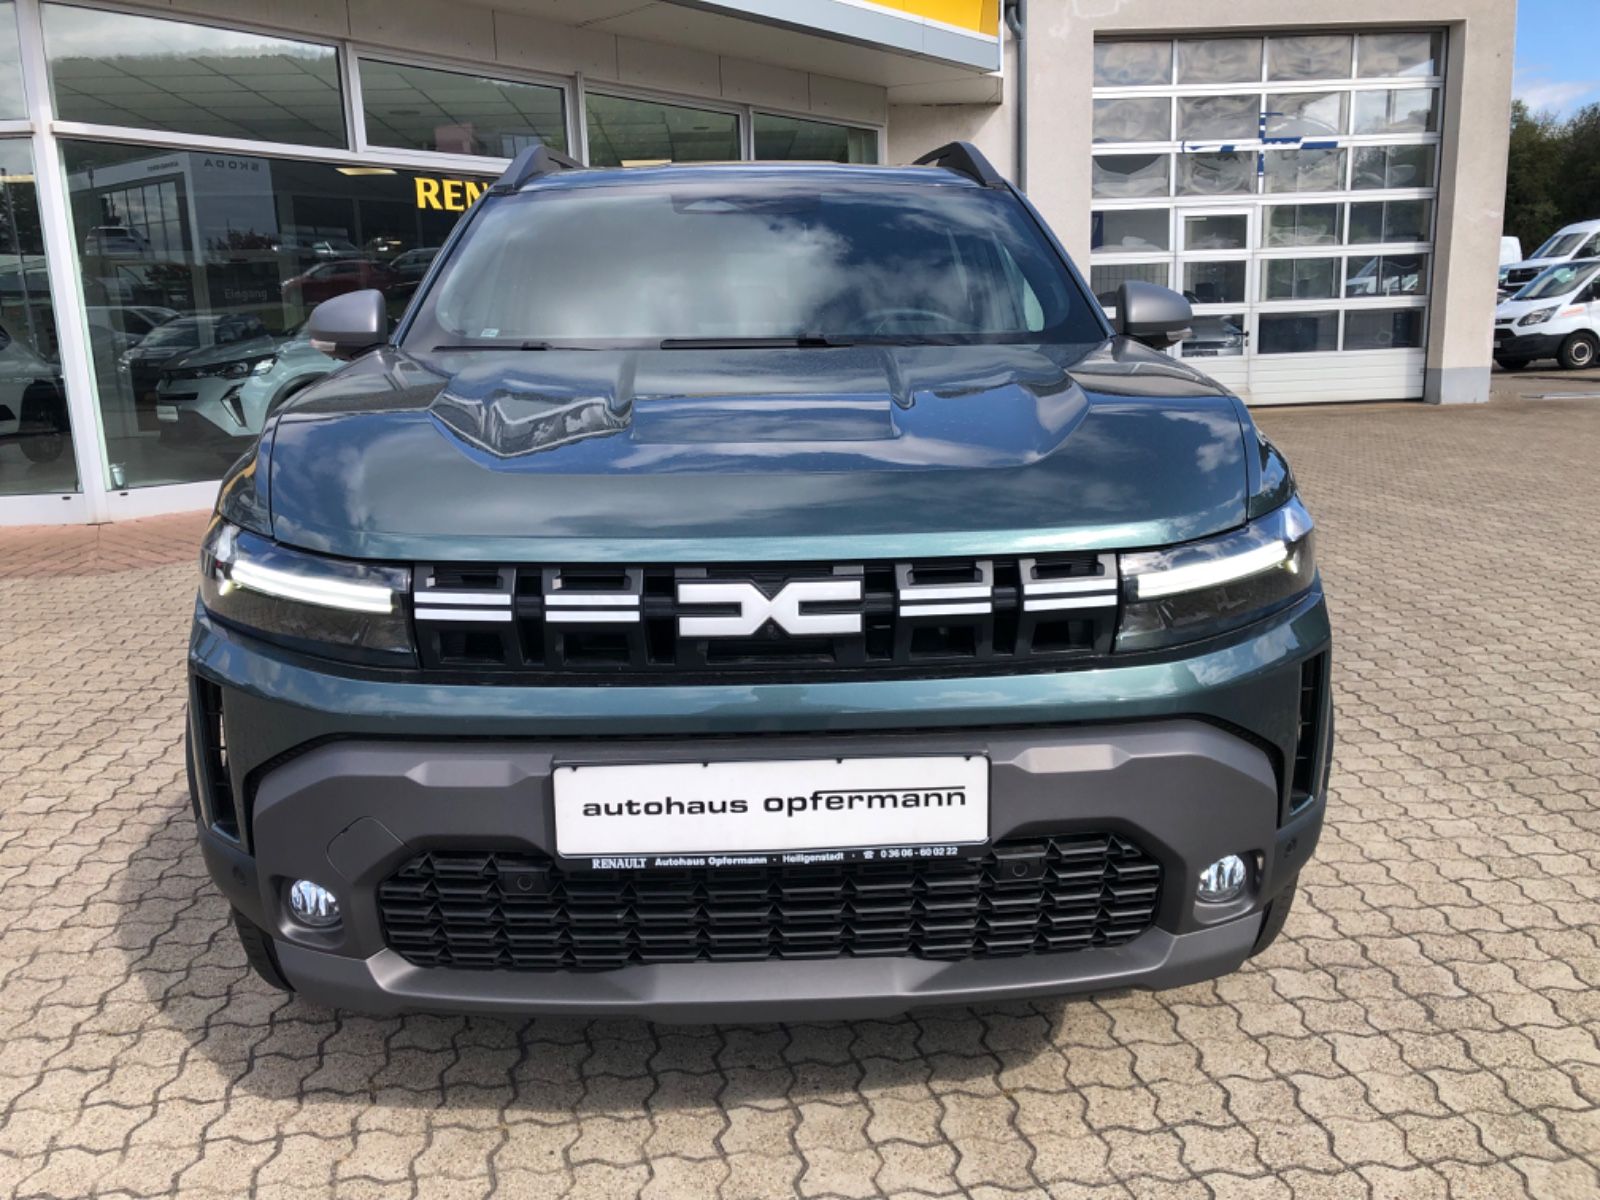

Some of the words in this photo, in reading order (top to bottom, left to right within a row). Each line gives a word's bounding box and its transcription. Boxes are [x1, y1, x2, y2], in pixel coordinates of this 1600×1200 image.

[582, 796, 748, 817] autohaus
[763, 786, 966, 817] opfermann
[592, 858, 647, 869] RENAULT
[655, 857, 705, 866] Autohaus
[708, 856, 767, 867] Opfermann
[782, 852, 844, 864] Heiligenstadt
